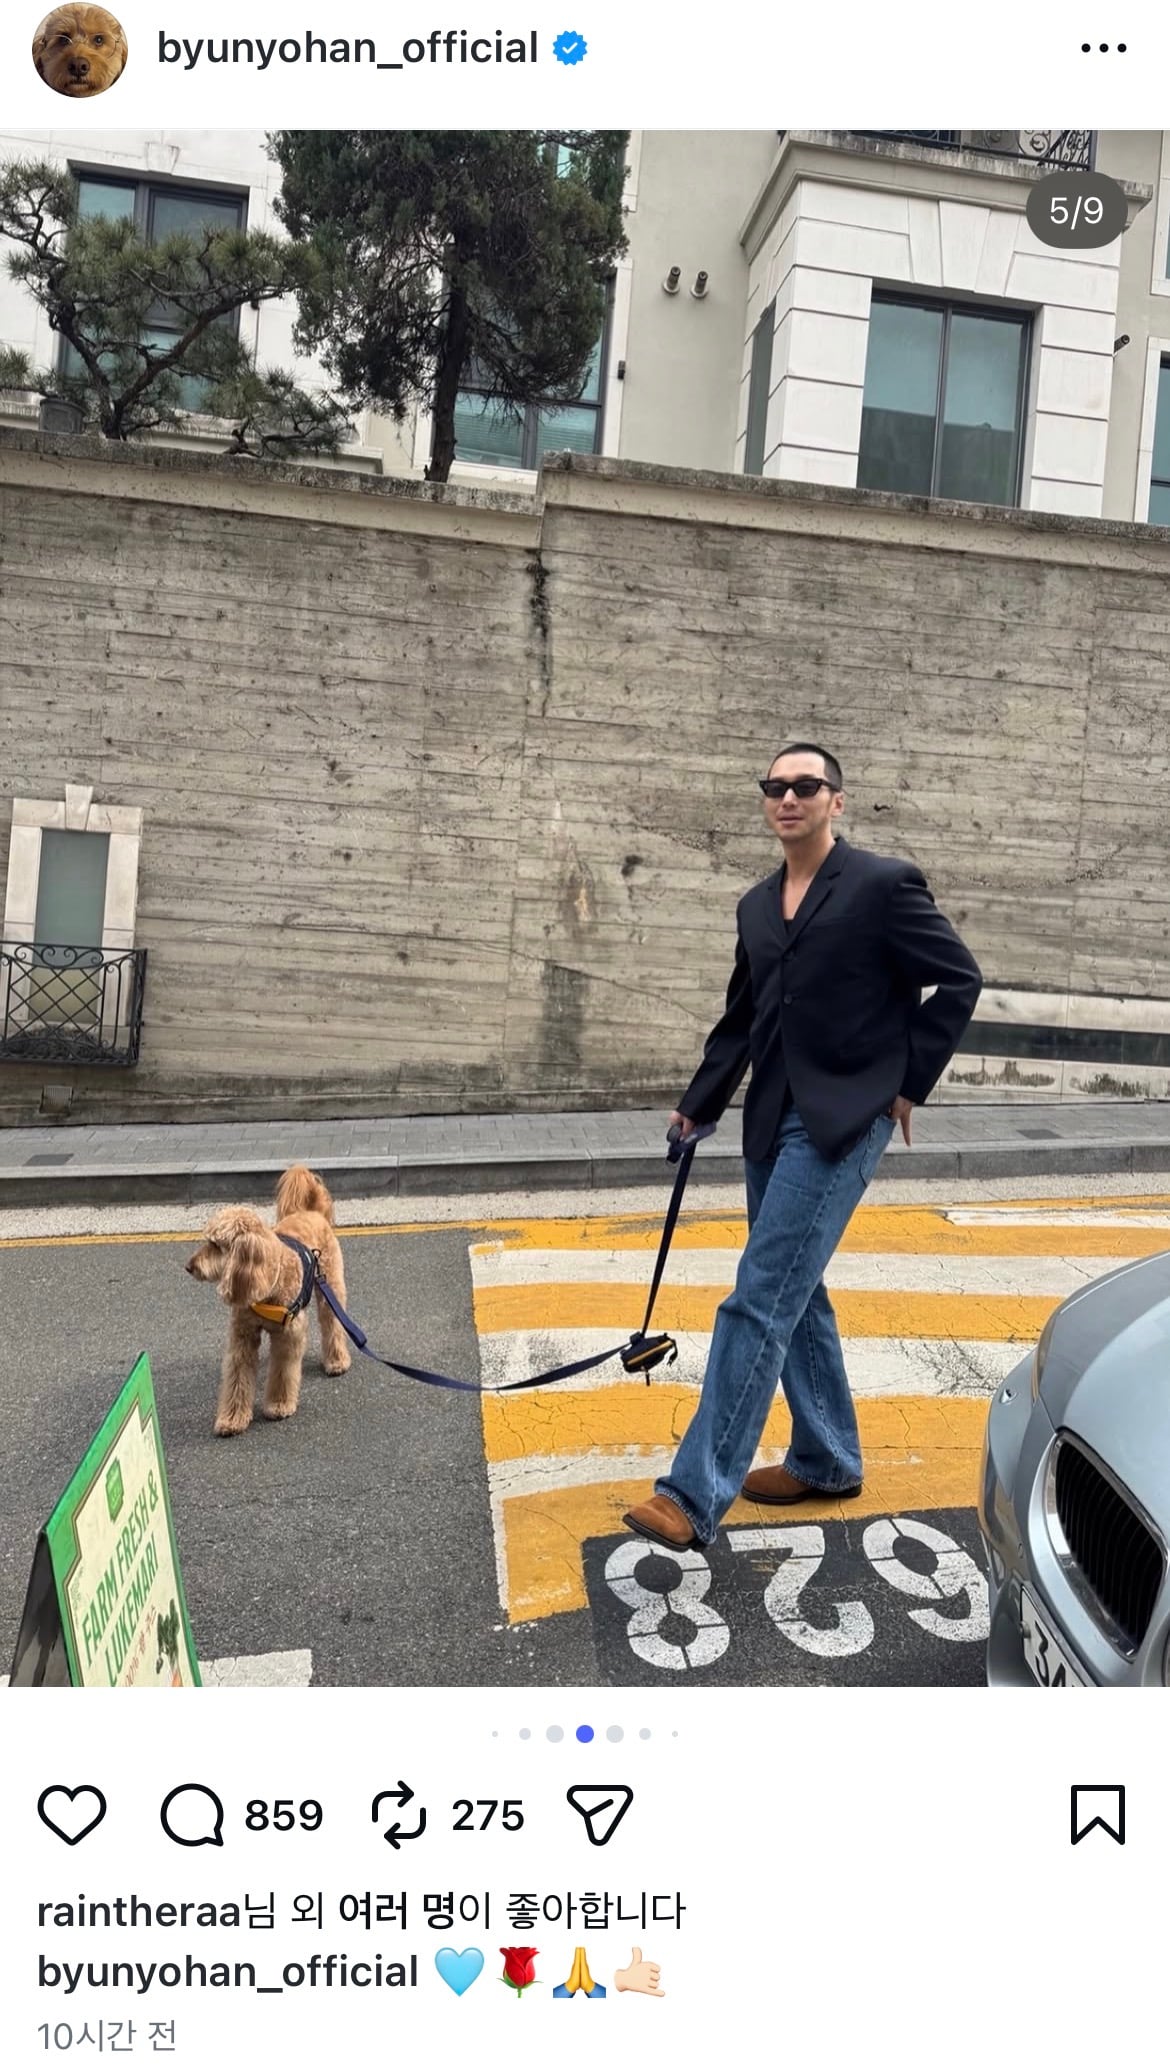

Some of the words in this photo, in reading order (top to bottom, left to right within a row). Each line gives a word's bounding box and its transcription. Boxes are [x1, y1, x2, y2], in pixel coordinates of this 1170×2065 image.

[82, 1557, 119, 1669] FARM
[116, 1485, 150, 1587] FRESH
[147, 1470, 159, 1512] &
[105, 1532, 159, 1687] LUKEMARI
